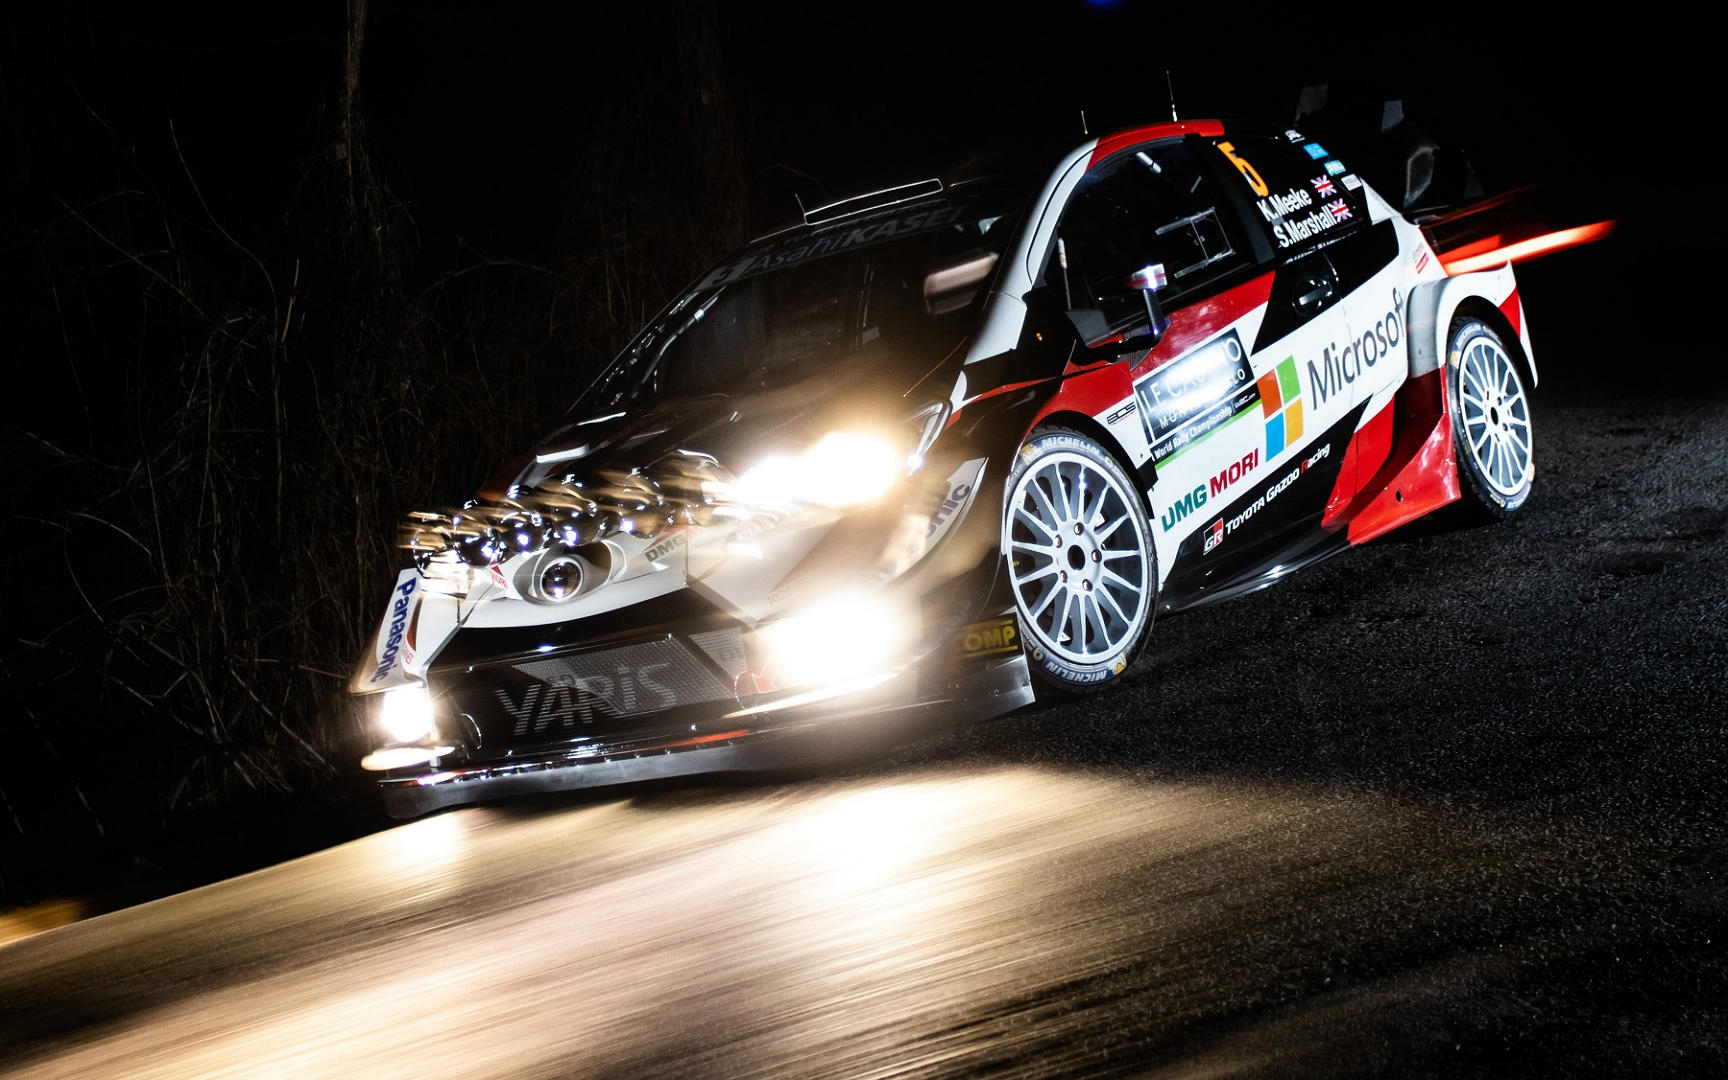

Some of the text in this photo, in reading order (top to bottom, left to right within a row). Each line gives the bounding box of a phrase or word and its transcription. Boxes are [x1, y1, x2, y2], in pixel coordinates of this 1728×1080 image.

[1217, 141, 1269, 197] 5
[1256, 187, 1312, 222] K.Meeke
[1273, 206, 1338, 249] S.Marshall
[1306, 287, 1404, 411] Microsoft
[1154, 441, 1172, 460] World
[1172, 431, 1189, 450] Rally
[1189, 406, 1233, 436] Championship
[1209, 448, 1259, 497] MORI
[1225, 497, 1265, 534] TOYOTA
[1265, 470, 1300, 502] GAZOO
[1301, 443, 1330, 474] Racing
[644, 534, 685, 562] DMG
[370, 577, 416, 683] Panasonic
[964, 625, 1016, 651] OMP
[1045, 661, 1107, 683] MICHELIN
